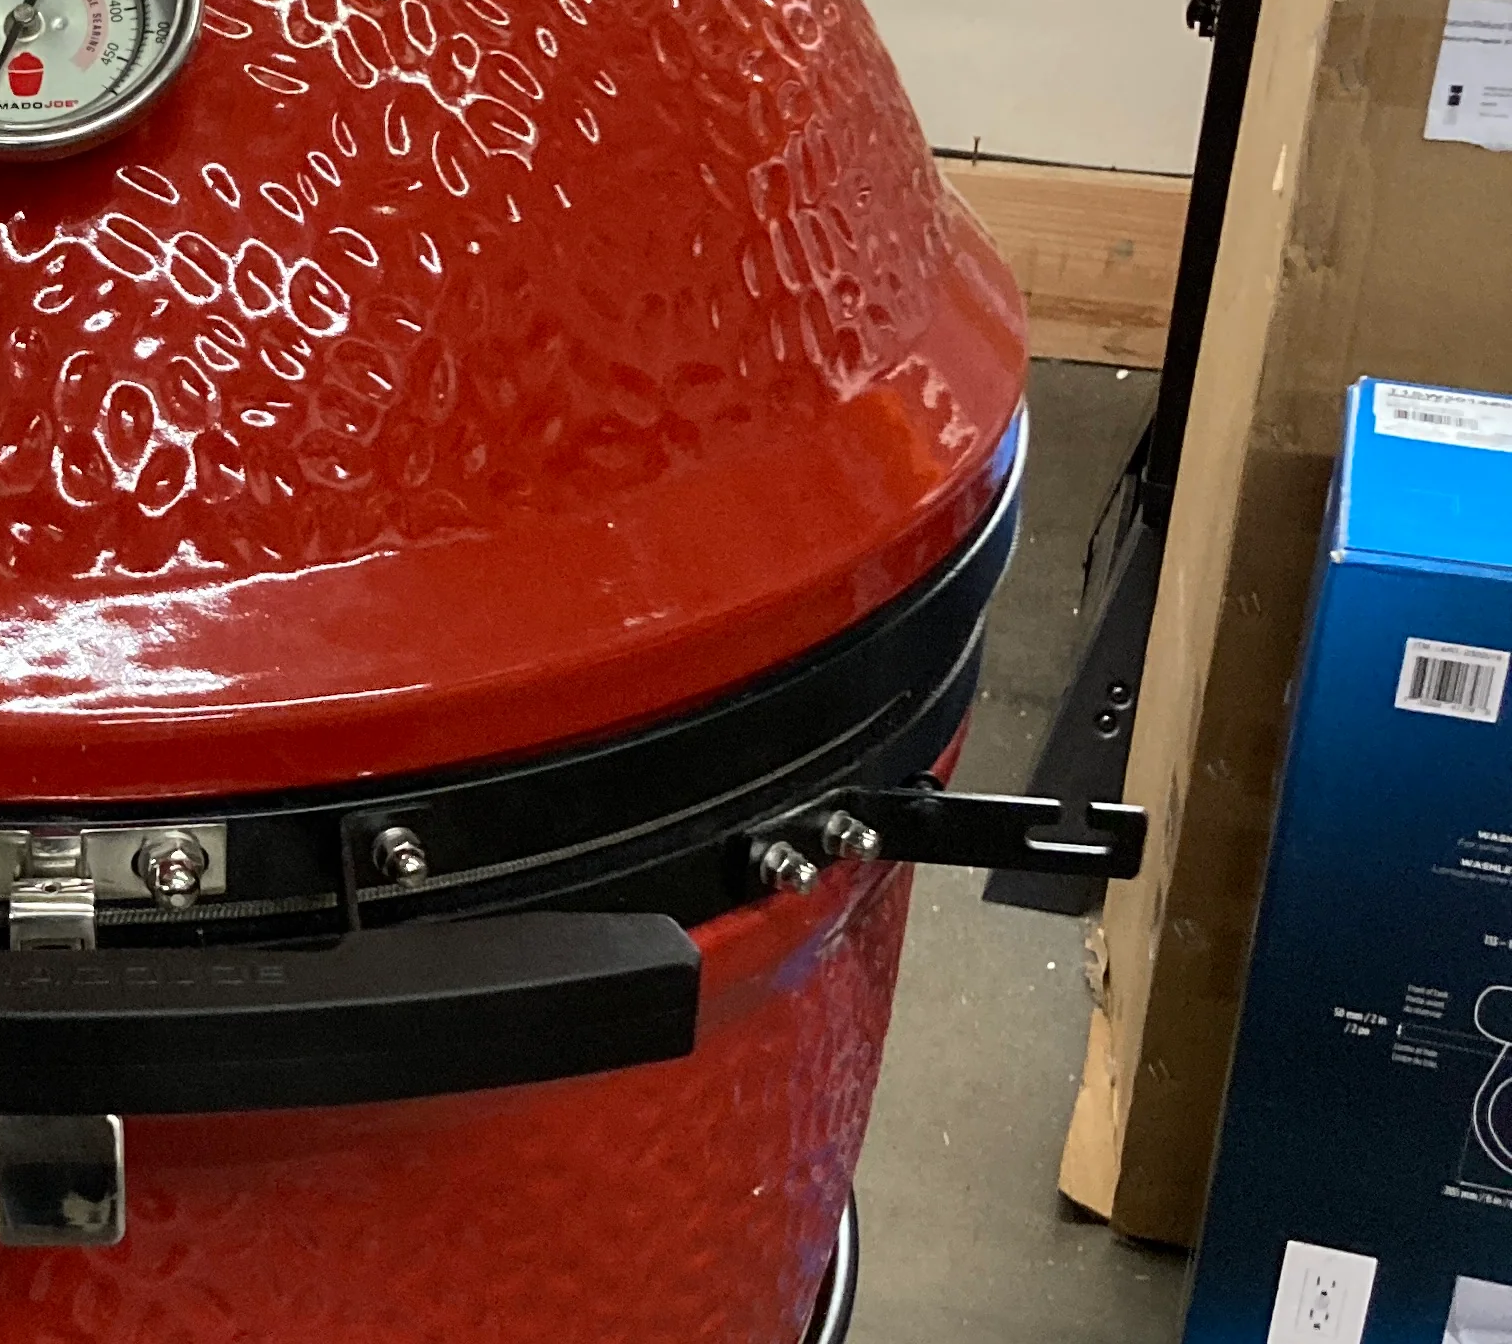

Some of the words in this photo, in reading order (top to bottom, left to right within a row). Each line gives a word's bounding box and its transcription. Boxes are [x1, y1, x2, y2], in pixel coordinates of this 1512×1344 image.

[108, 0, 124, 24] 400
[85, 12, 103, 54] SEARING
[155, 20, 171, 45] 800
[100, 42, 120, 66] 450
